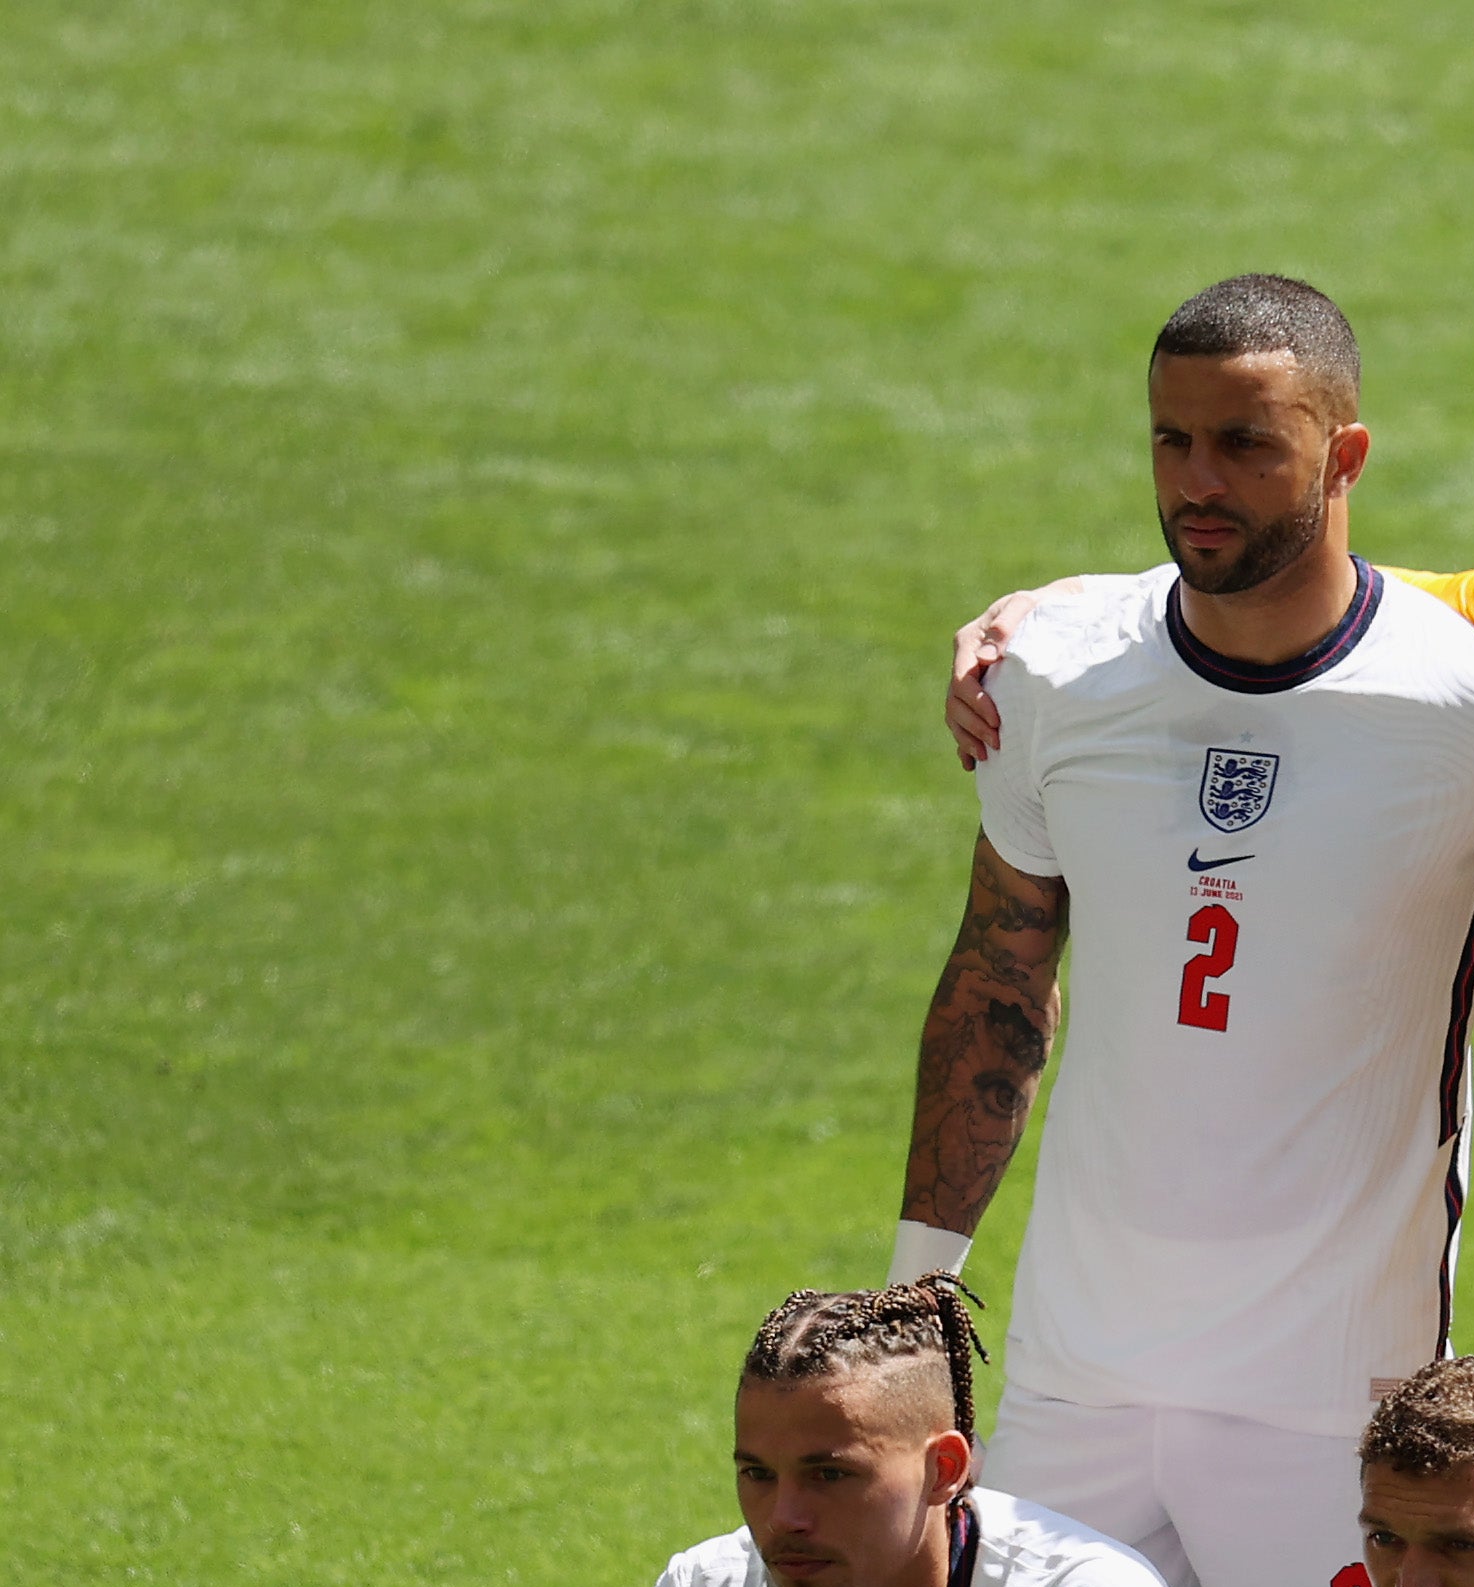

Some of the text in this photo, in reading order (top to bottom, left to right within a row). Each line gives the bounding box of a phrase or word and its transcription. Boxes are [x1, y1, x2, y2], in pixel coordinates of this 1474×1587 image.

[1199, 876, 1237, 890] CROATIA
[1201, 888, 1223, 899] JUNE
[1177, 903, 1239, 1032] 2
